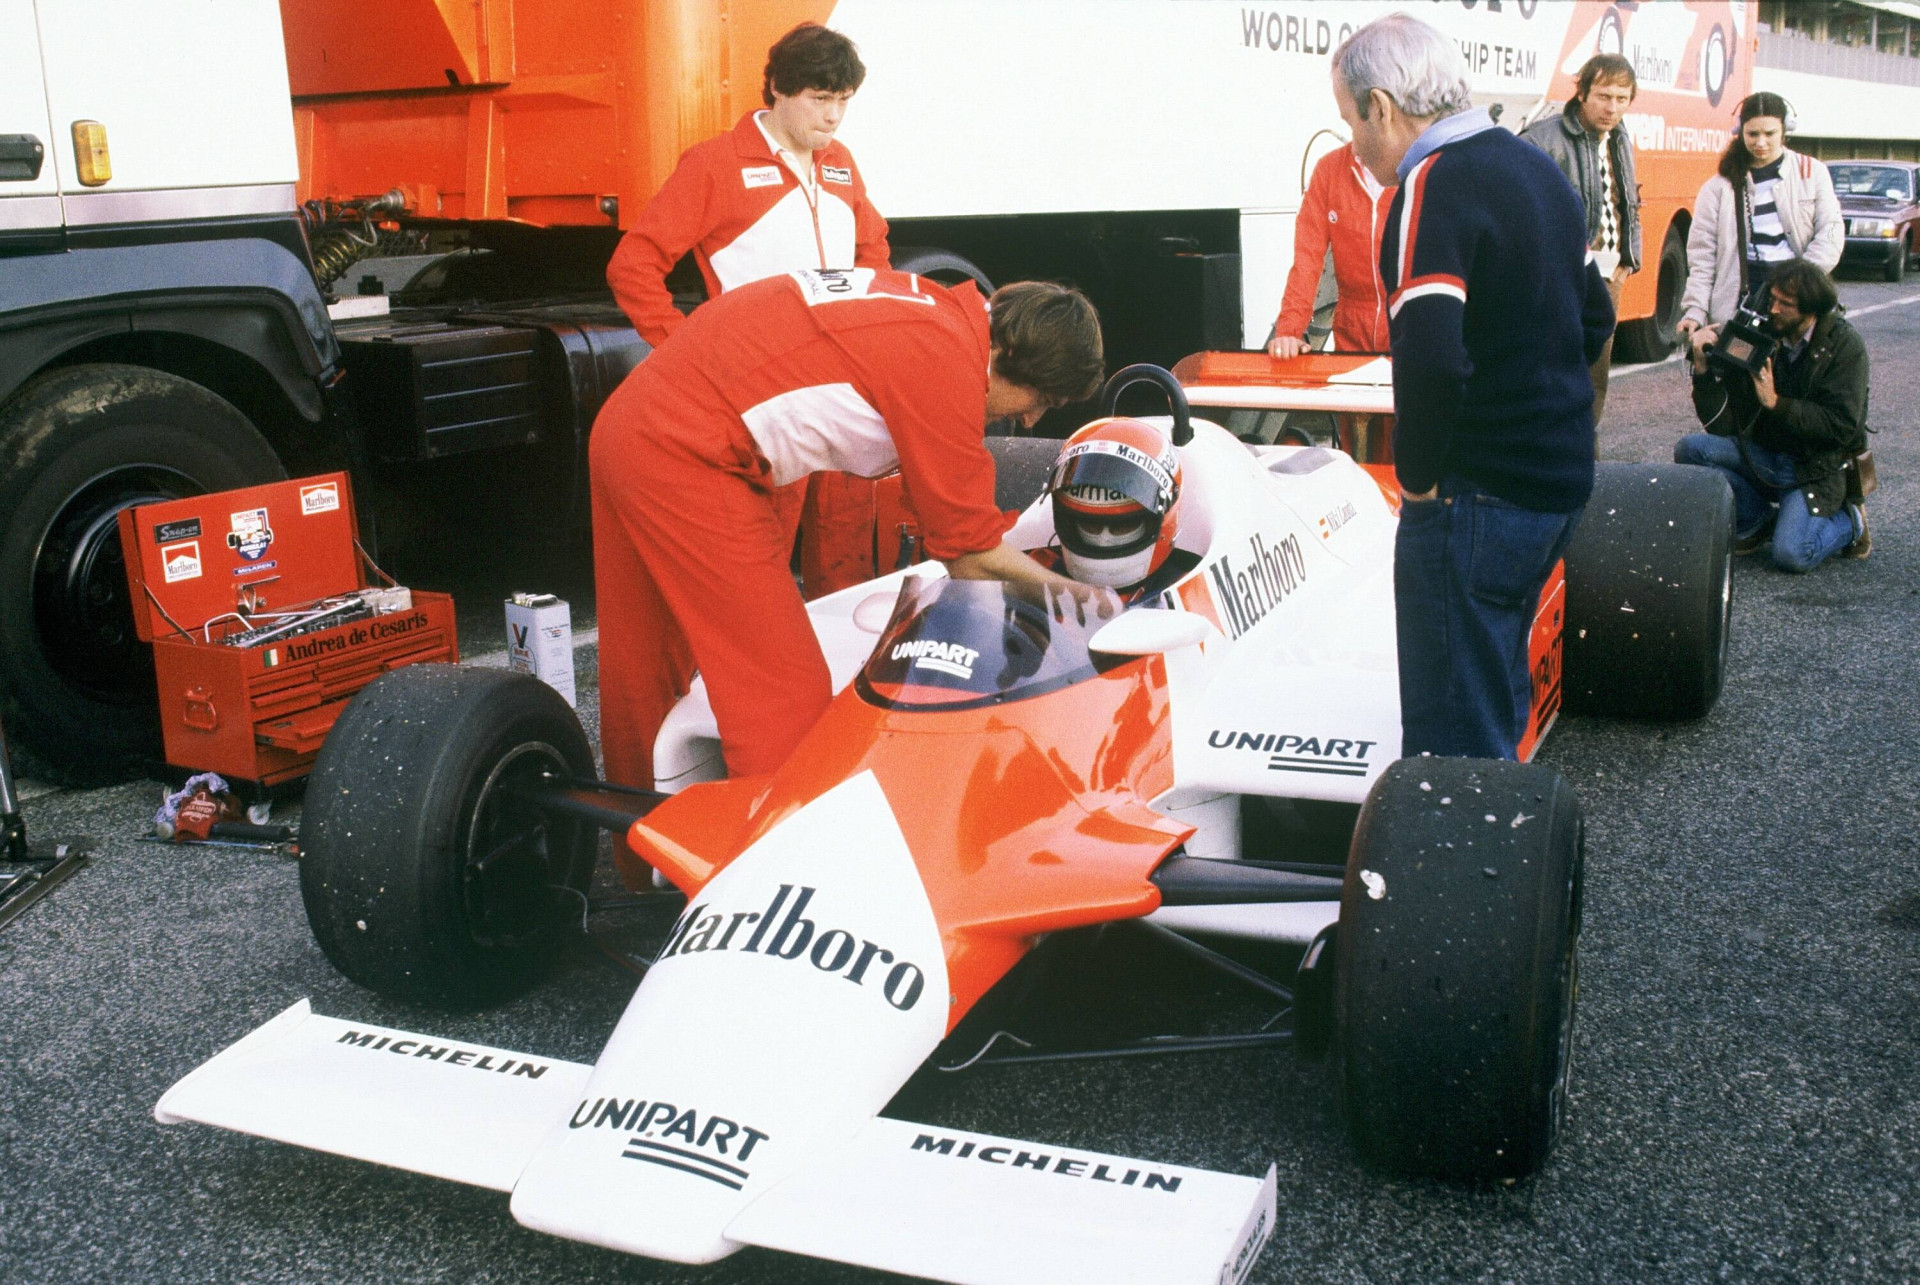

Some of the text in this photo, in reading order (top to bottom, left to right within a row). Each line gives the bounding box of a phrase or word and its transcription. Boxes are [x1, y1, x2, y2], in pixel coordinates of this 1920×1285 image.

[1241, 8, 1331, 56] WORLD
[1494, 45, 1537, 80] TEAM
[1633, 44, 1673, 84] Marlboro
[1115, 444, 1169, 490] Marlboro
[305, 493, 336, 507] Marlboro
[160, 525, 198, 540] Snap-on
[168, 559, 198, 575] Marlboro
[1209, 532, 1306, 642] Marlboro
[285, 612, 428, 663] Andrea de Cesaris
[891, 639, 980, 667] UNIPART
[1207, 729, 1378, 759] UNIPART
[654, 884, 925, 1011] Marlboro
[335, 1030, 550, 1080] MICHELIN
[569, 1097, 770, 1162] UNIPART
[909, 1133, 1183, 1194] MICHELIN
